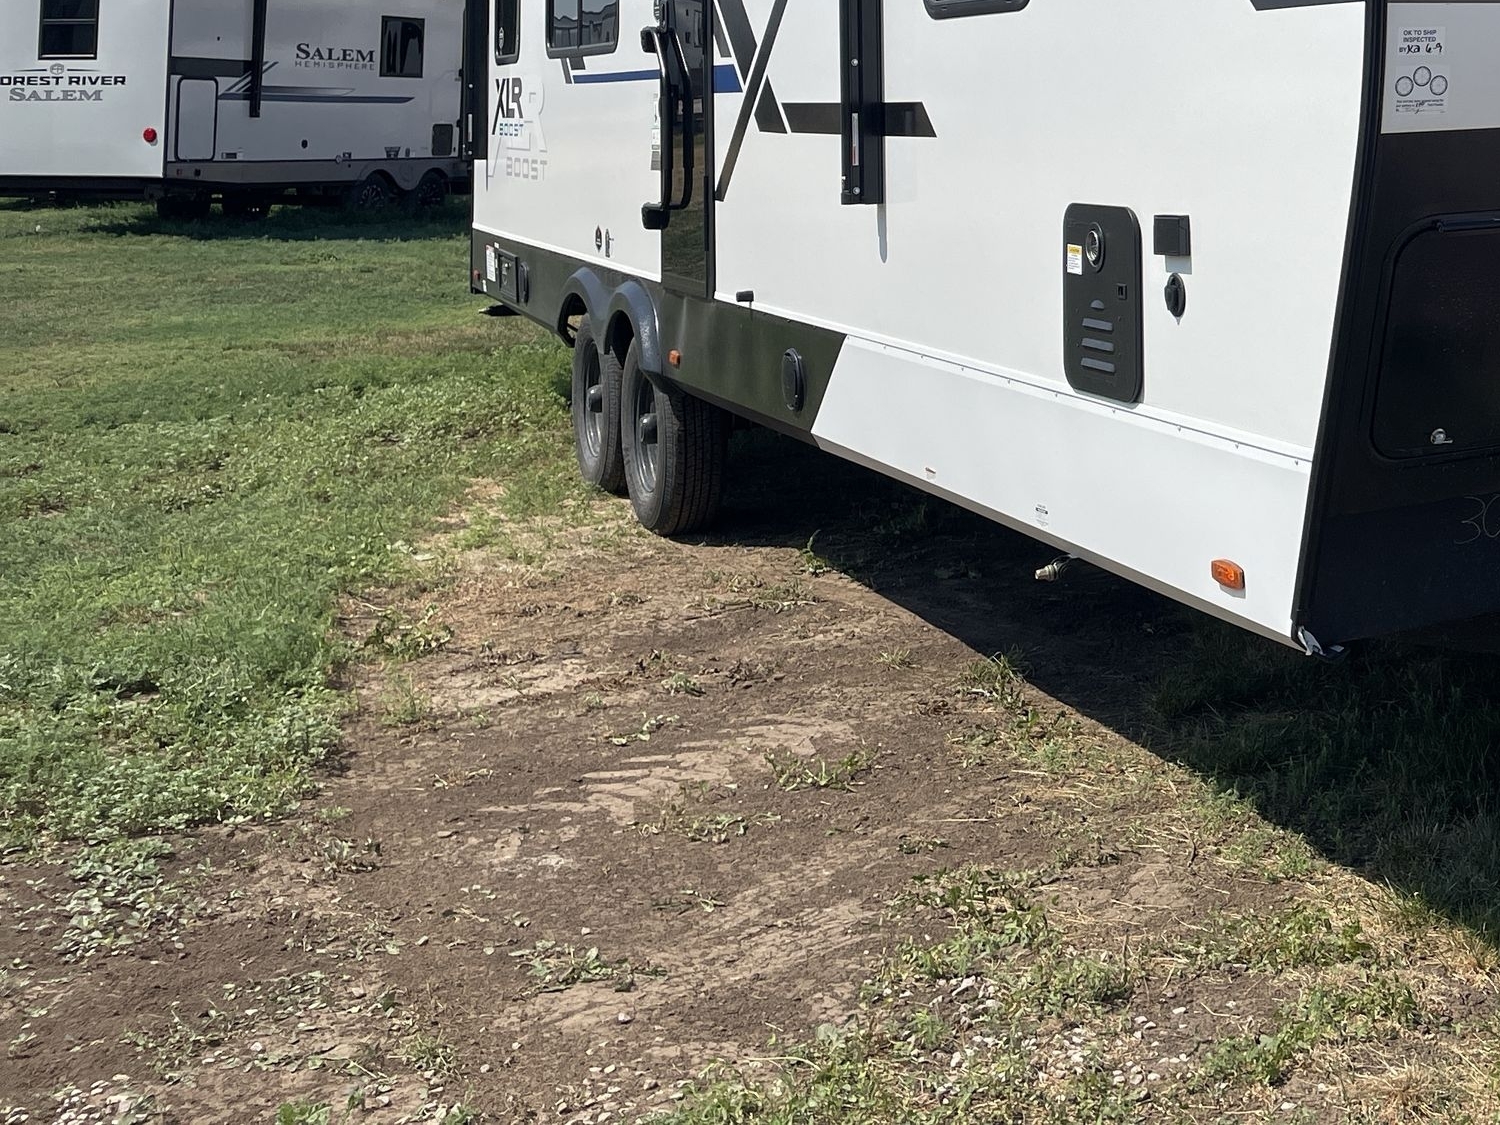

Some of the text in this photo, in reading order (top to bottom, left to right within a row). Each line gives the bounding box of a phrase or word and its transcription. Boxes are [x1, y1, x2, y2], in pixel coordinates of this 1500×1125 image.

[295, 42, 376, 63] SALEM
[0, 75, 126, 86] OREST RIVER
[9, 87, 103, 102] SALEM
[491, 77, 524, 136] XLR
[505, 156, 548, 182] BOOST
